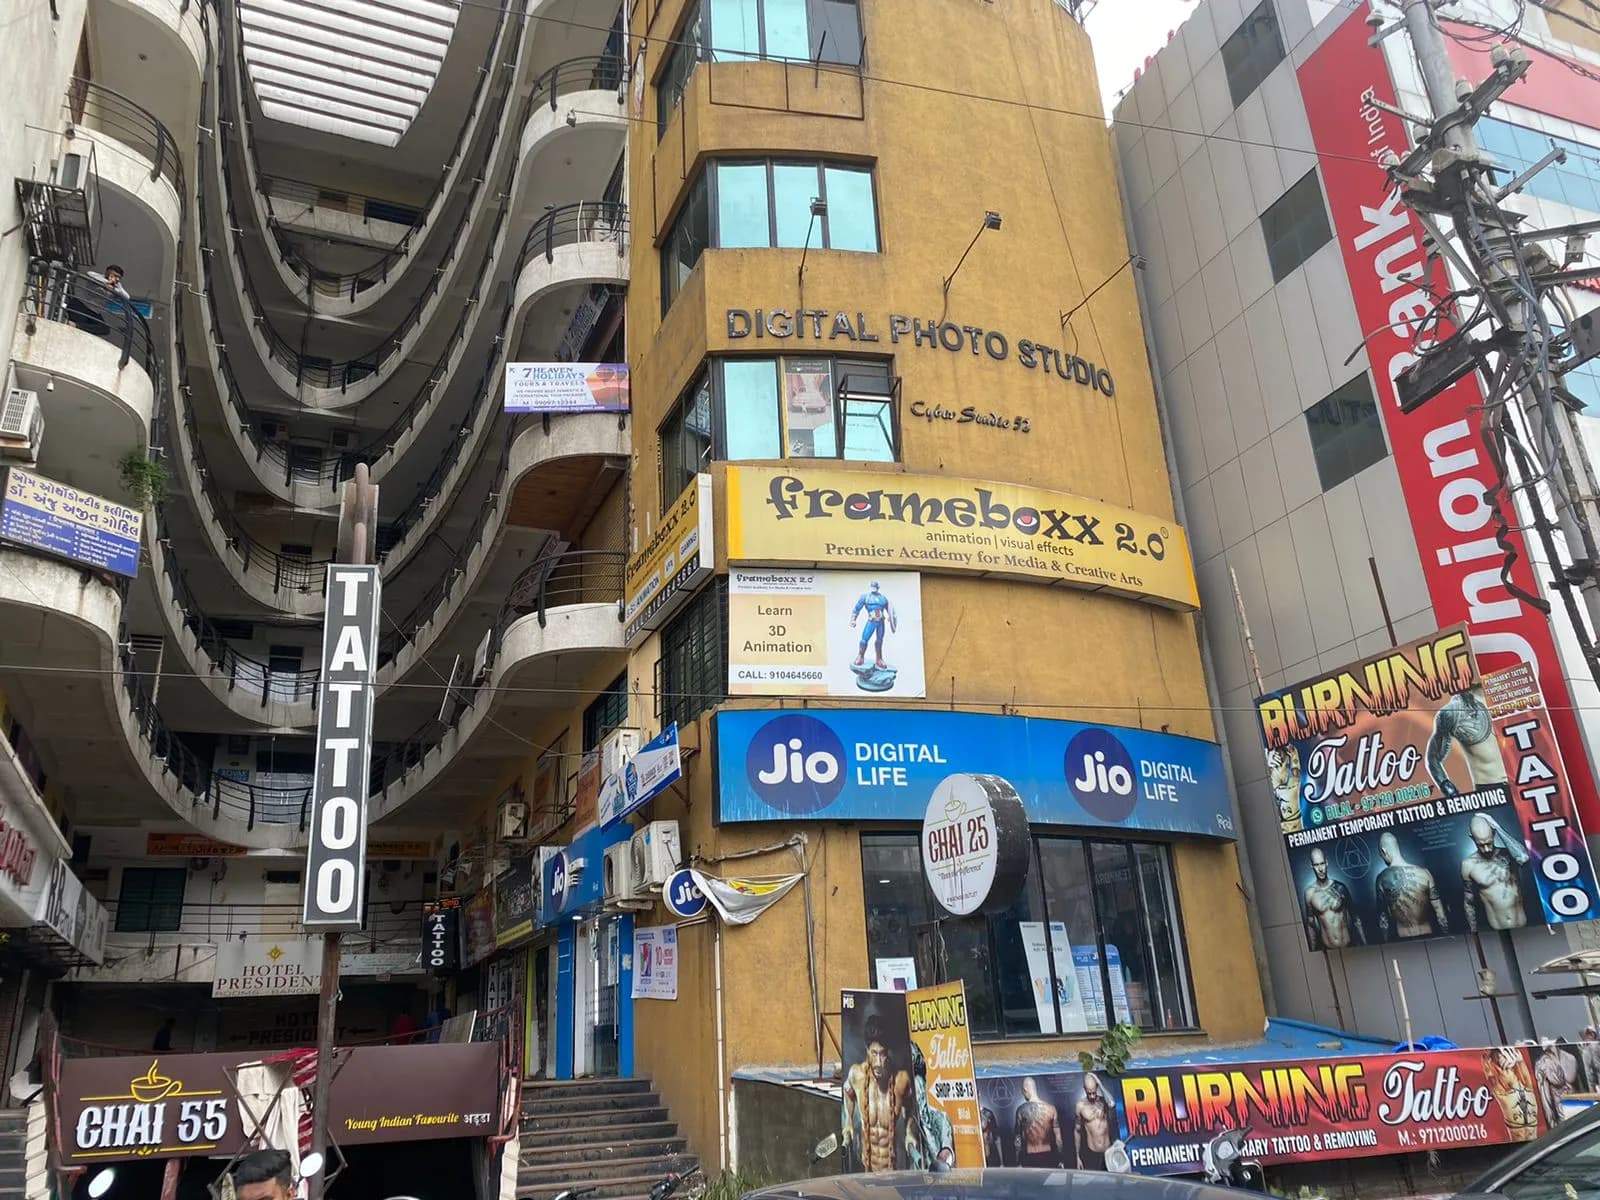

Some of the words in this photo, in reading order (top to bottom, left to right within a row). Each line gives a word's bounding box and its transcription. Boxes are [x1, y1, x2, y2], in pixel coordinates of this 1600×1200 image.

[726, 308, 879, 342] DIGITAL
[889, 313, 1009, 361] PHOTO
[1017, 338, 1115, 398] STUDIO
[522, 367, 533, 378] 7
[533, 372, 585, 380] HOLIDAYS
[766, 475, 1104, 546] frameboxx
[926, 530, 992, 546] animation
[1000, 534, 1034, 550] visual
[1037, 541, 1075, 557] effects
[825, 543, 895, 558] Premier
[899, 547, 972, 565] Academy
[978, 551, 1000, 564] for
[1004, 555, 1047, 570] Media
[1051, 560, 1062, 572] &
[1065, 562, 1117, 581] Creative
[1120, 572, 1144, 587] Arts
[757, 605, 793, 616] Learn
[743, 641, 812, 653] Animation
[768, 625, 787, 637] 3D
[738, 670, 767, 680] CALL:
[769, 671, 823, 680] 9104645660
[1510, 667, 1528, 679] TATTOO
[1512, 678, 1529, 689] TATTOO
[1259, 630, 1473, 750] BURNING
[316, 571, 370, 914] TATTOO
[855, 742, 947, 764] DIGITAL
[758, 738, 839, 785] Jio
[857, 767, 908, 786] LIFE
[1075, 750, 1132, 796] Jio
[1140, 759, 1198, 785] DIGITAL
[1304, 732, 1421, 803] Tattoo
[1144, 783, 1179, 802] LIFE
[1327, 800, 1355, 820] BILAL
[1361, 792, 1394, 812] 97120
[1395, 784, 1431, 805] 00216
[1288, 825, 1339, 849] PERMANENT
[1338, 811, 1397, 838] TEMPORARY
[1397, 803, 1434, 825] TATTOO
[1436, 801, 1446, 815] &
[1447, 788, 1507, 814] REMOVING
[1505, 721, 1589, 916] TATTOO
[928, 823, 964, 863] CHAI
[967, 814, 989, 853] 25
[552, 866, 564, 896] Jio
[675, 881, 704, 905] Jio
[430, 914, 446, 966] TATTOO
[243, 964, 305, 977] HOTEL
[909, 994, 965, 1032] BURNING
[928, 1033, 969, 1070] Tattoo
[935, 1083, 951, 1097] SHOP
[1121, 1063, 1370, 1136] BURNING
[1378, 1061, 1493, 1125] Tattoo
[76, 1103, 167, 1149] CHAI
[177, 1099, 228, 1143] 55
[345, 1118, 377, 1132] Young
[1420, 1123, 1487, 1145] 9712000216
[1132, 1143, 1200, 1166] PERMANENT
[1202, 1139, 1269, 1158] TRARY
[1271, 1135, 1311, 1155] TATTOO
[1313, 1136, 1321, 1151] &
[1324, 1129, 1377, 1152] REMOVING
